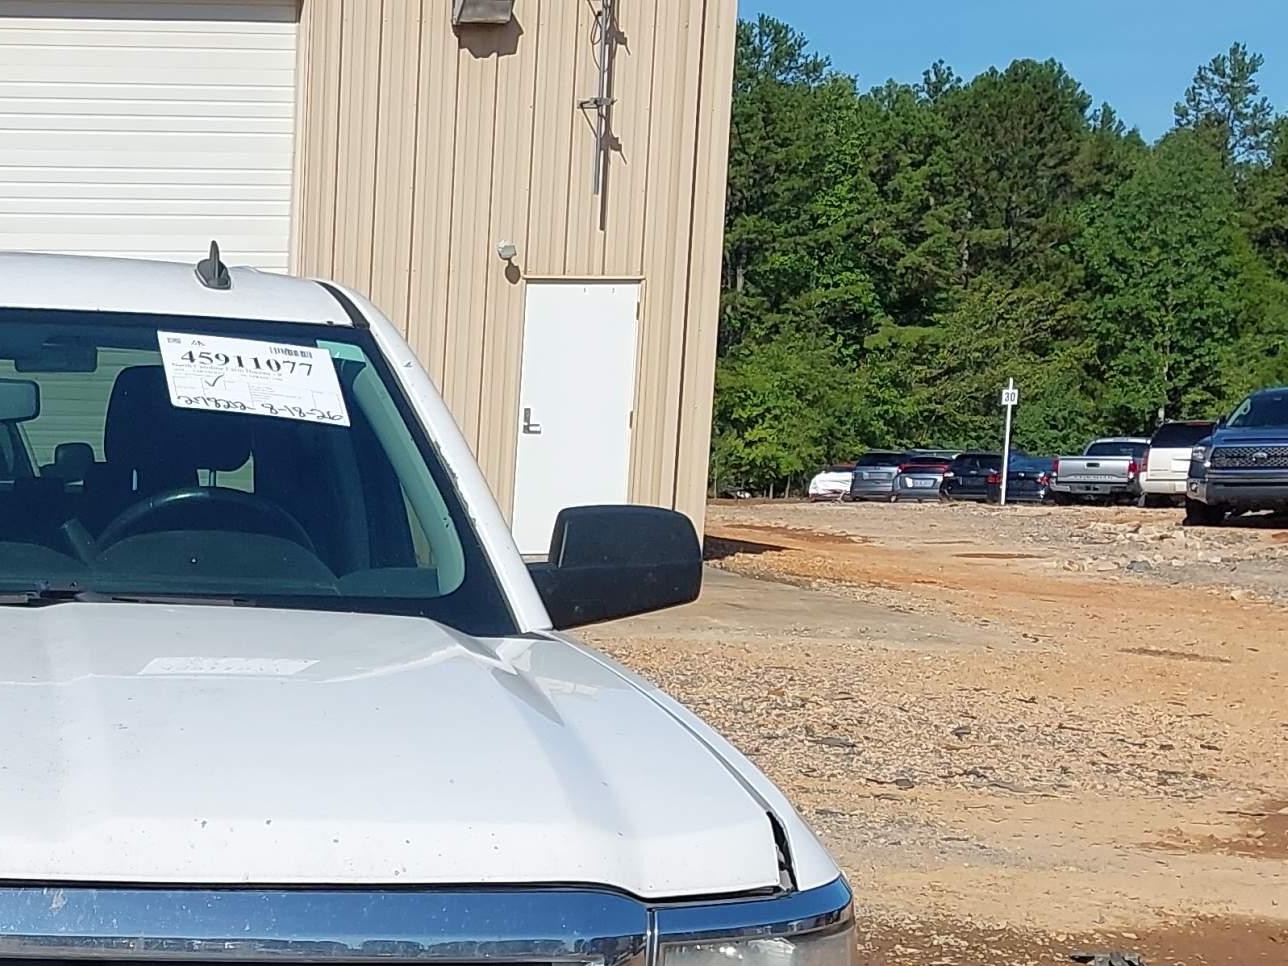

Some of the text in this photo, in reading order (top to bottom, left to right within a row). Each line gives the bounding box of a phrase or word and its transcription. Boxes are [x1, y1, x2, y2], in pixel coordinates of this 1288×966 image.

[180, 350, 313, 376] 45911077
[1004, 392, 1015, 402] 30
[261, 402, 344, 421] 8-18-26
